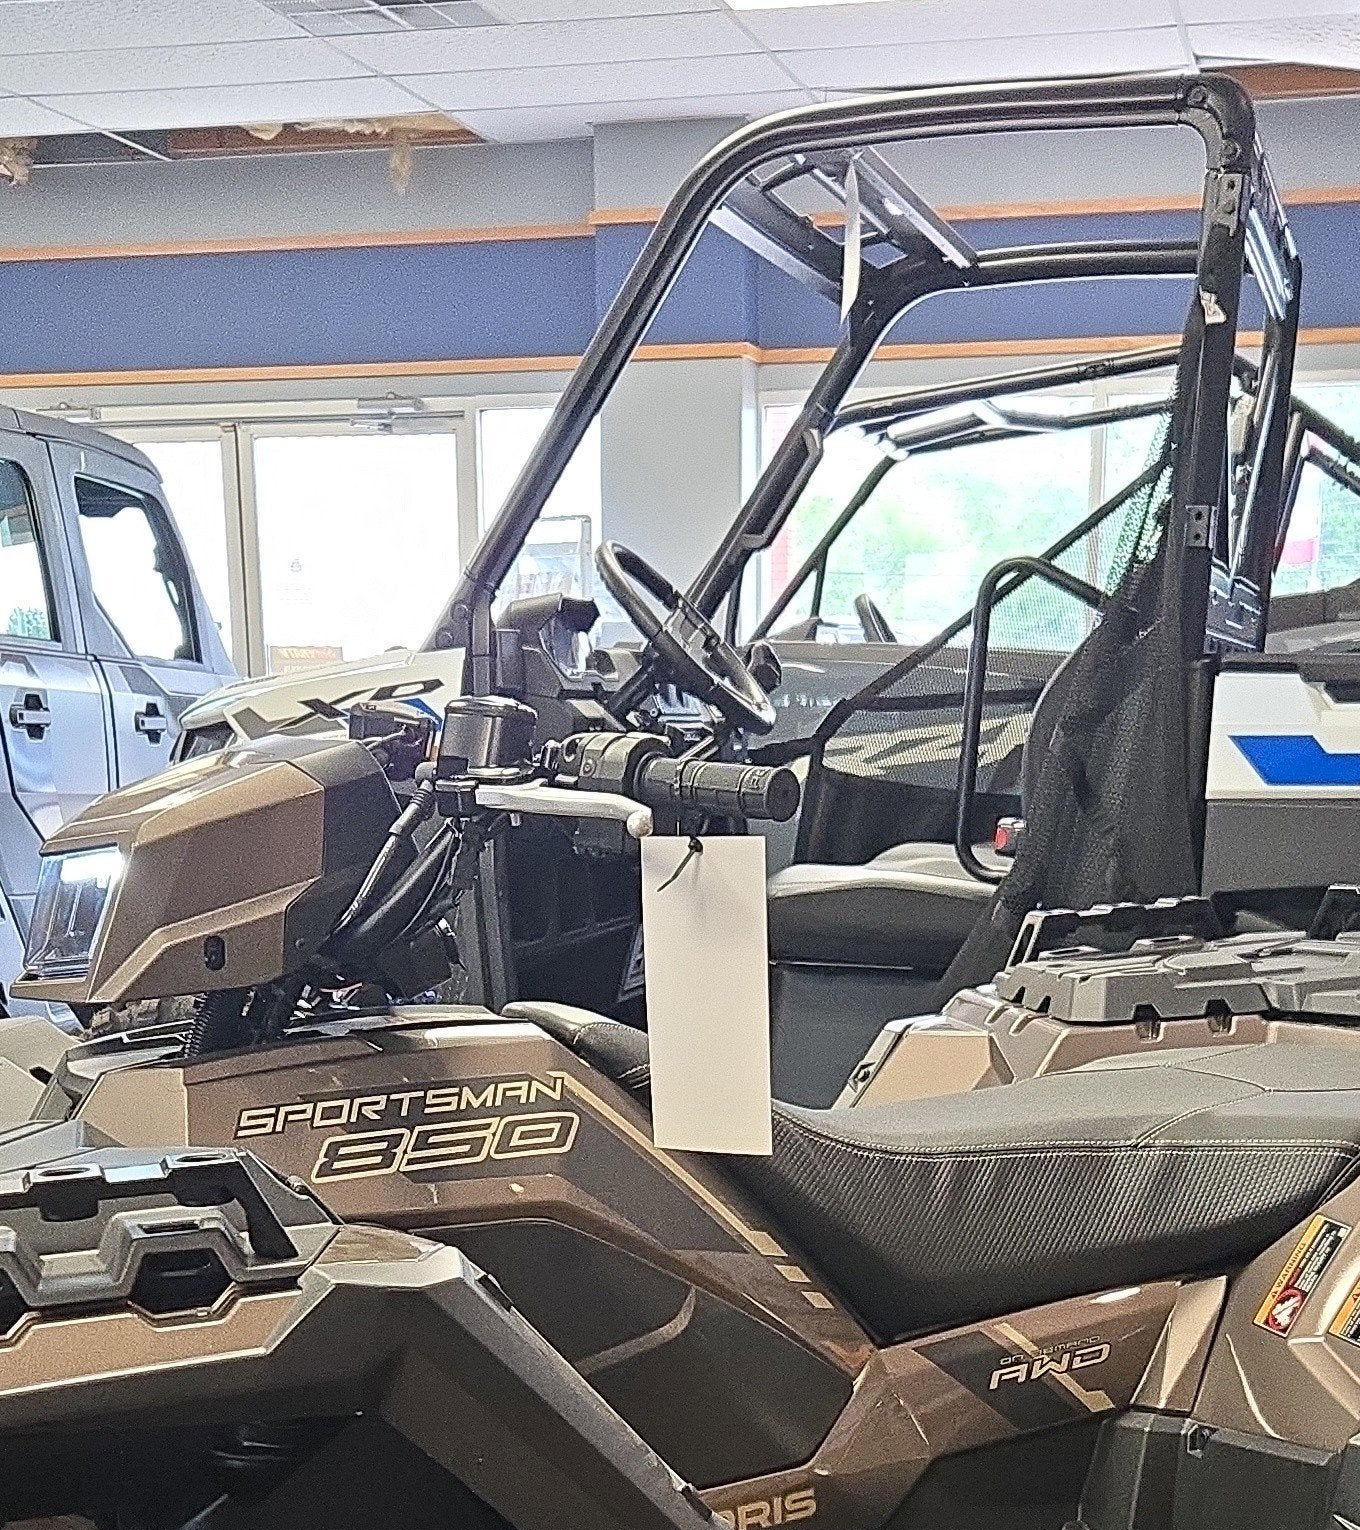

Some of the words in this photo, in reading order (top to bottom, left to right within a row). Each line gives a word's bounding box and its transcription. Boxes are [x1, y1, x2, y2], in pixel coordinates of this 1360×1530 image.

[235, 1077, 566, 1138] SPORTSMAN
[311, 1111, 580, 1184] 850
[1276, 1242, 1307, 1291] WARNING
[989, 1343, 1111, 1390] AWD
